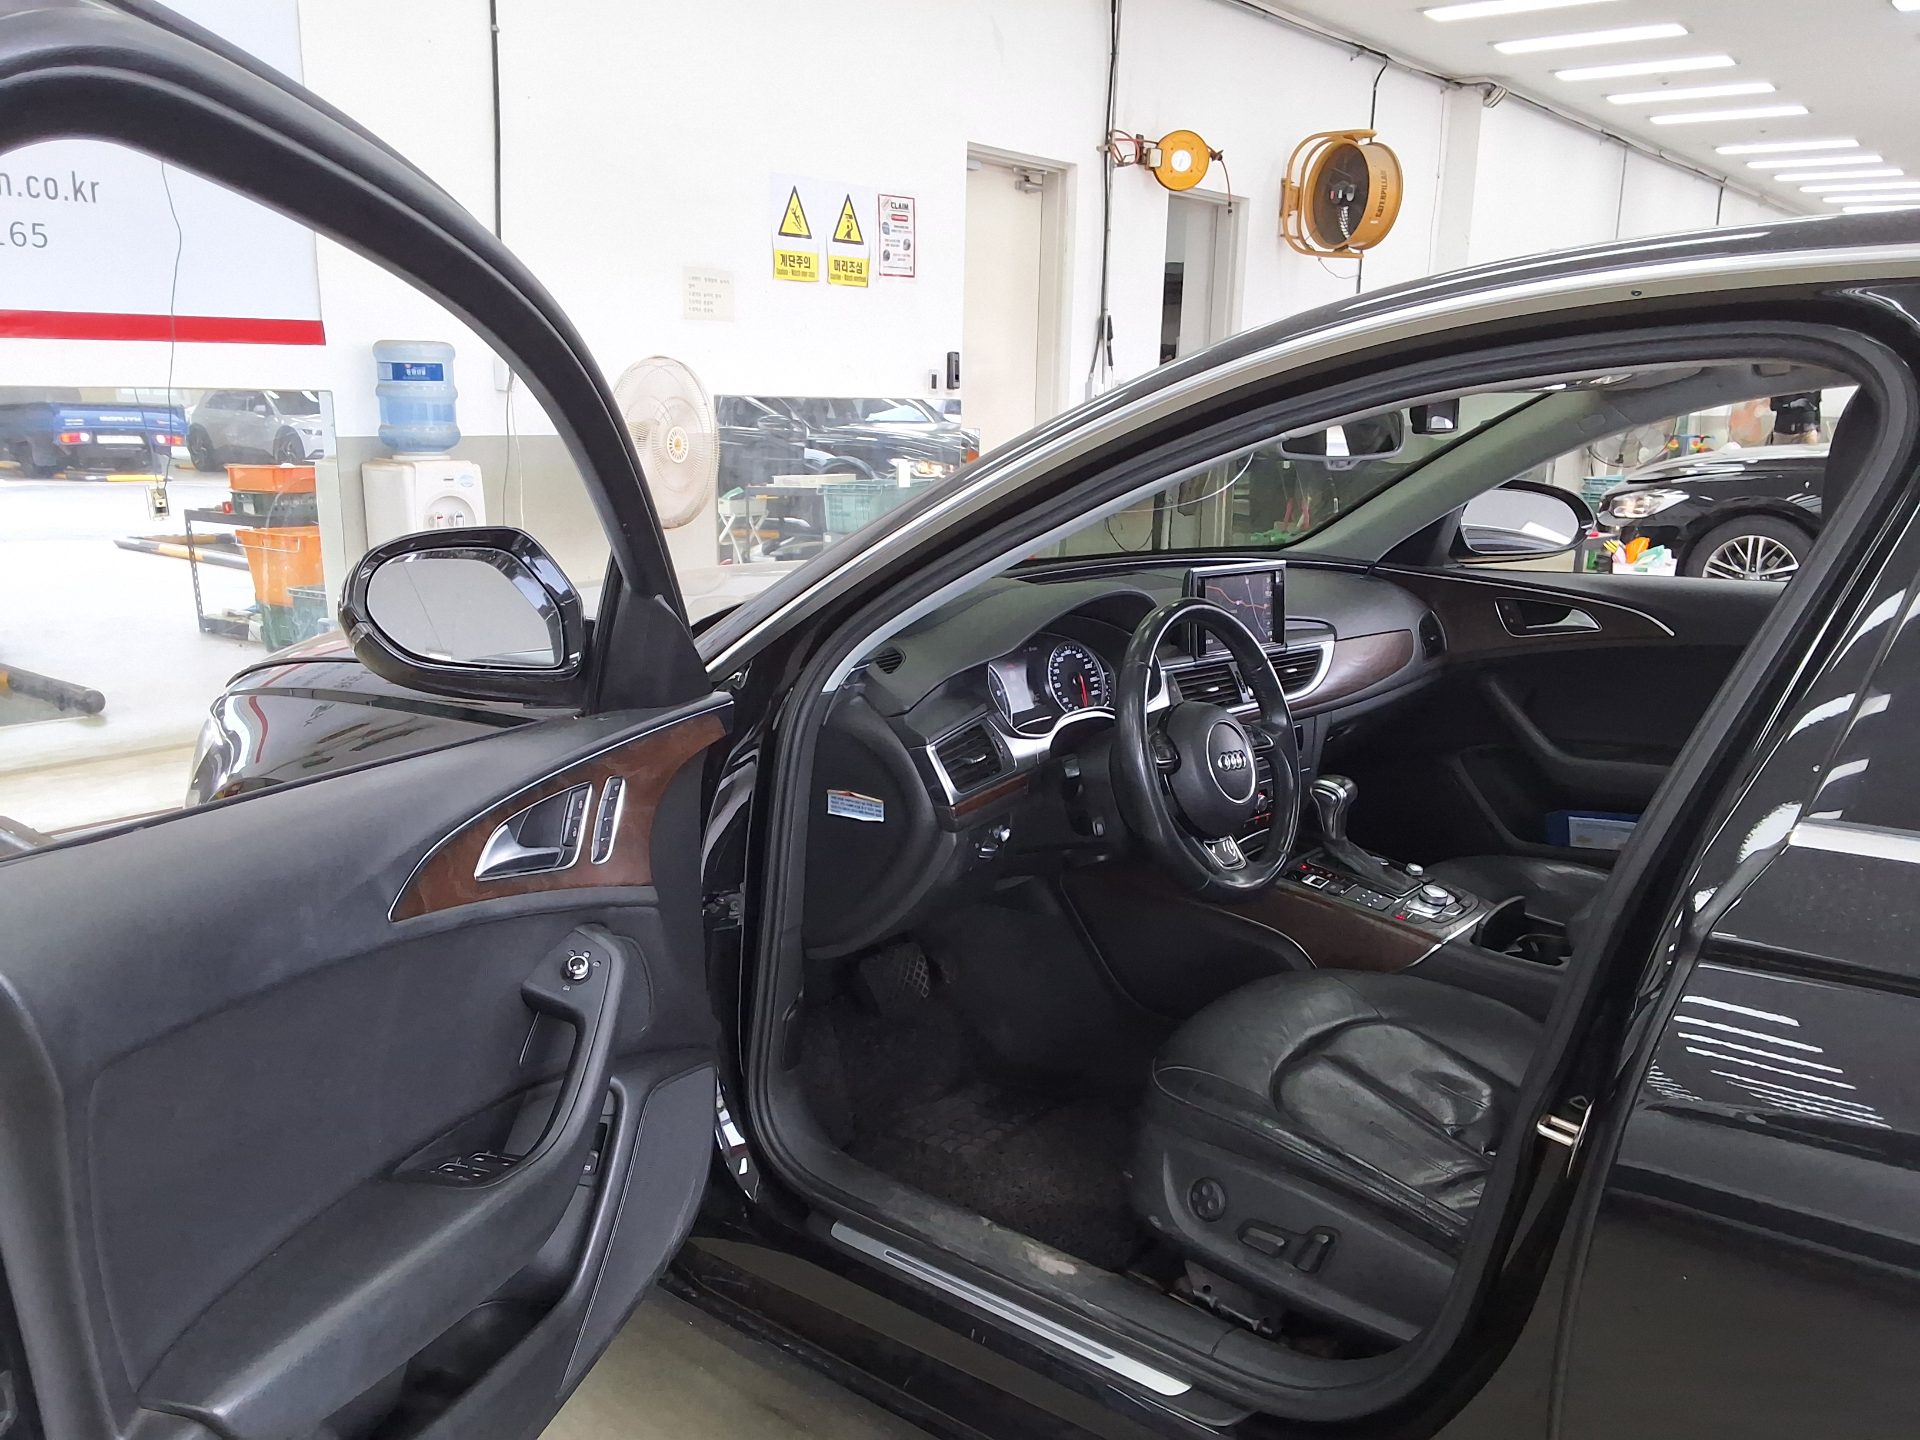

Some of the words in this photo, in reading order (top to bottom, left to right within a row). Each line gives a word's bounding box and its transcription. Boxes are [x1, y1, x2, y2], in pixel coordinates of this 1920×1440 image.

[0, 220, 48, 248] 65
[780, 254, 811, 269] 계단주의
[834, 259, 863, 274] 머리조심
